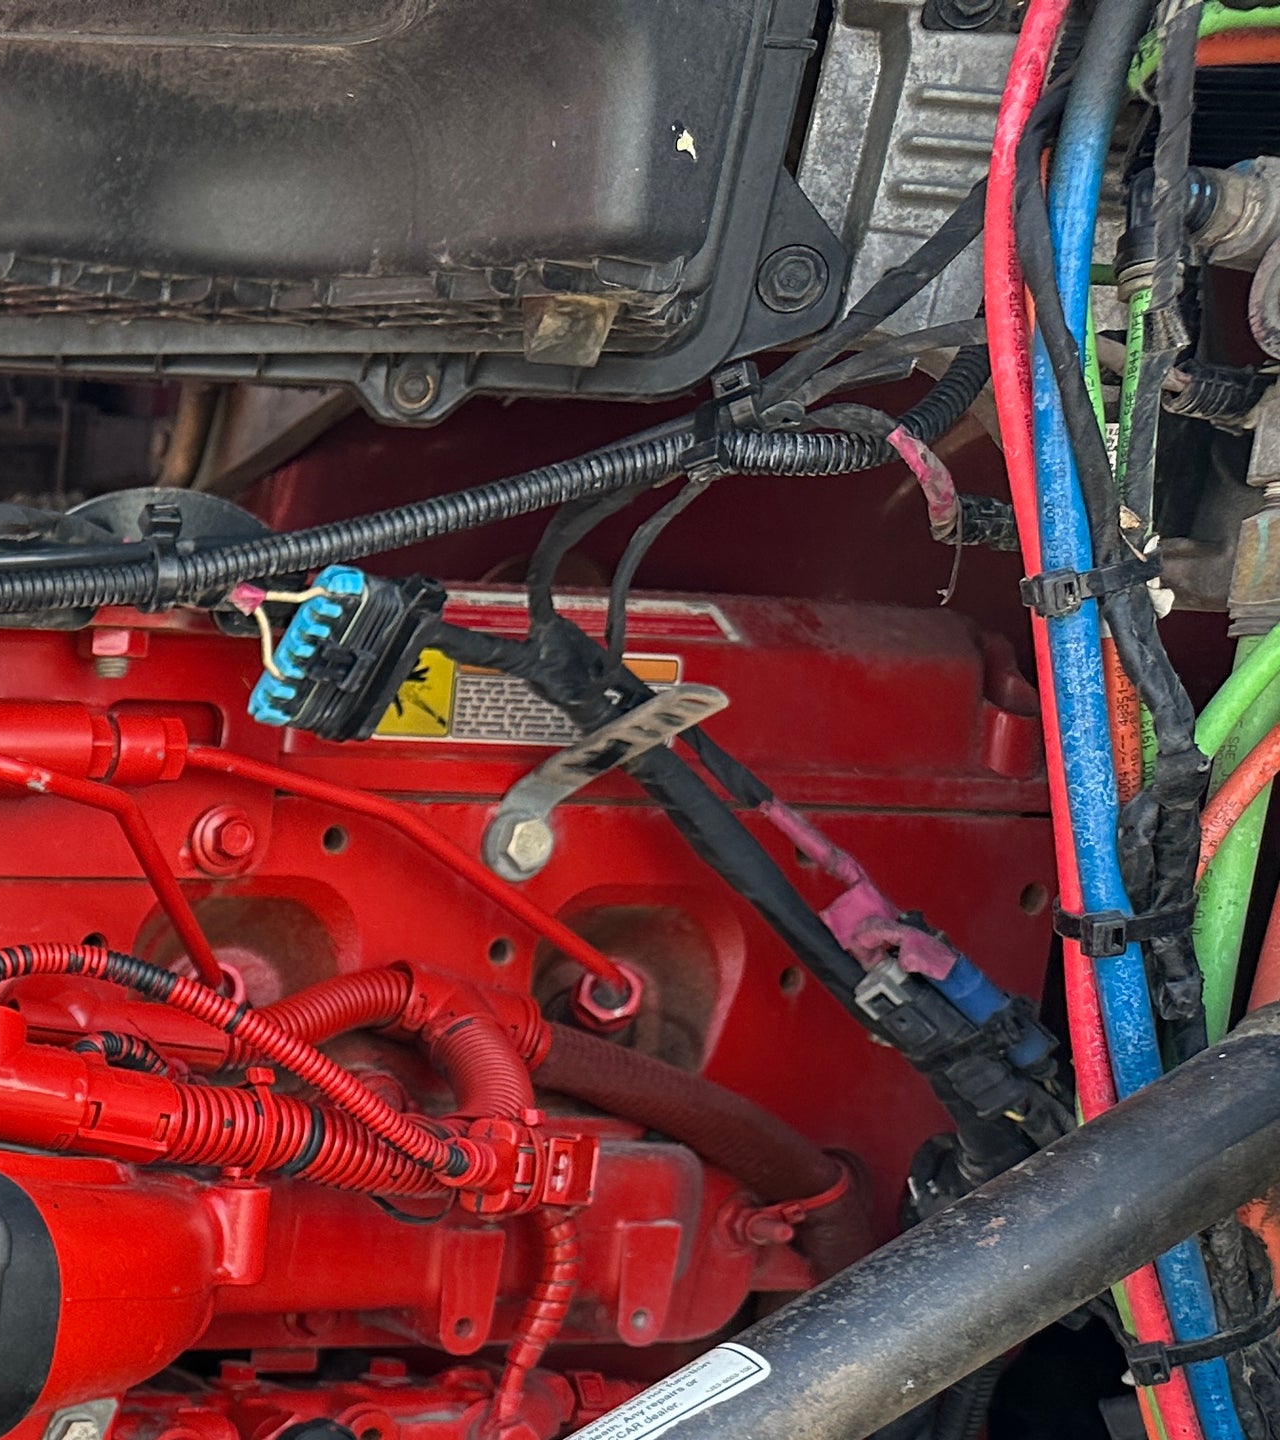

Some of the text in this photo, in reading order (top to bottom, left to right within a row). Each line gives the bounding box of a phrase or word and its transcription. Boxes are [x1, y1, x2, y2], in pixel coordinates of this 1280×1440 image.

[622, 1407, 645, 1425] Any
[644, 1384, 685, 1412] repairs
[642, 1397, 683, 1426] dealer.
